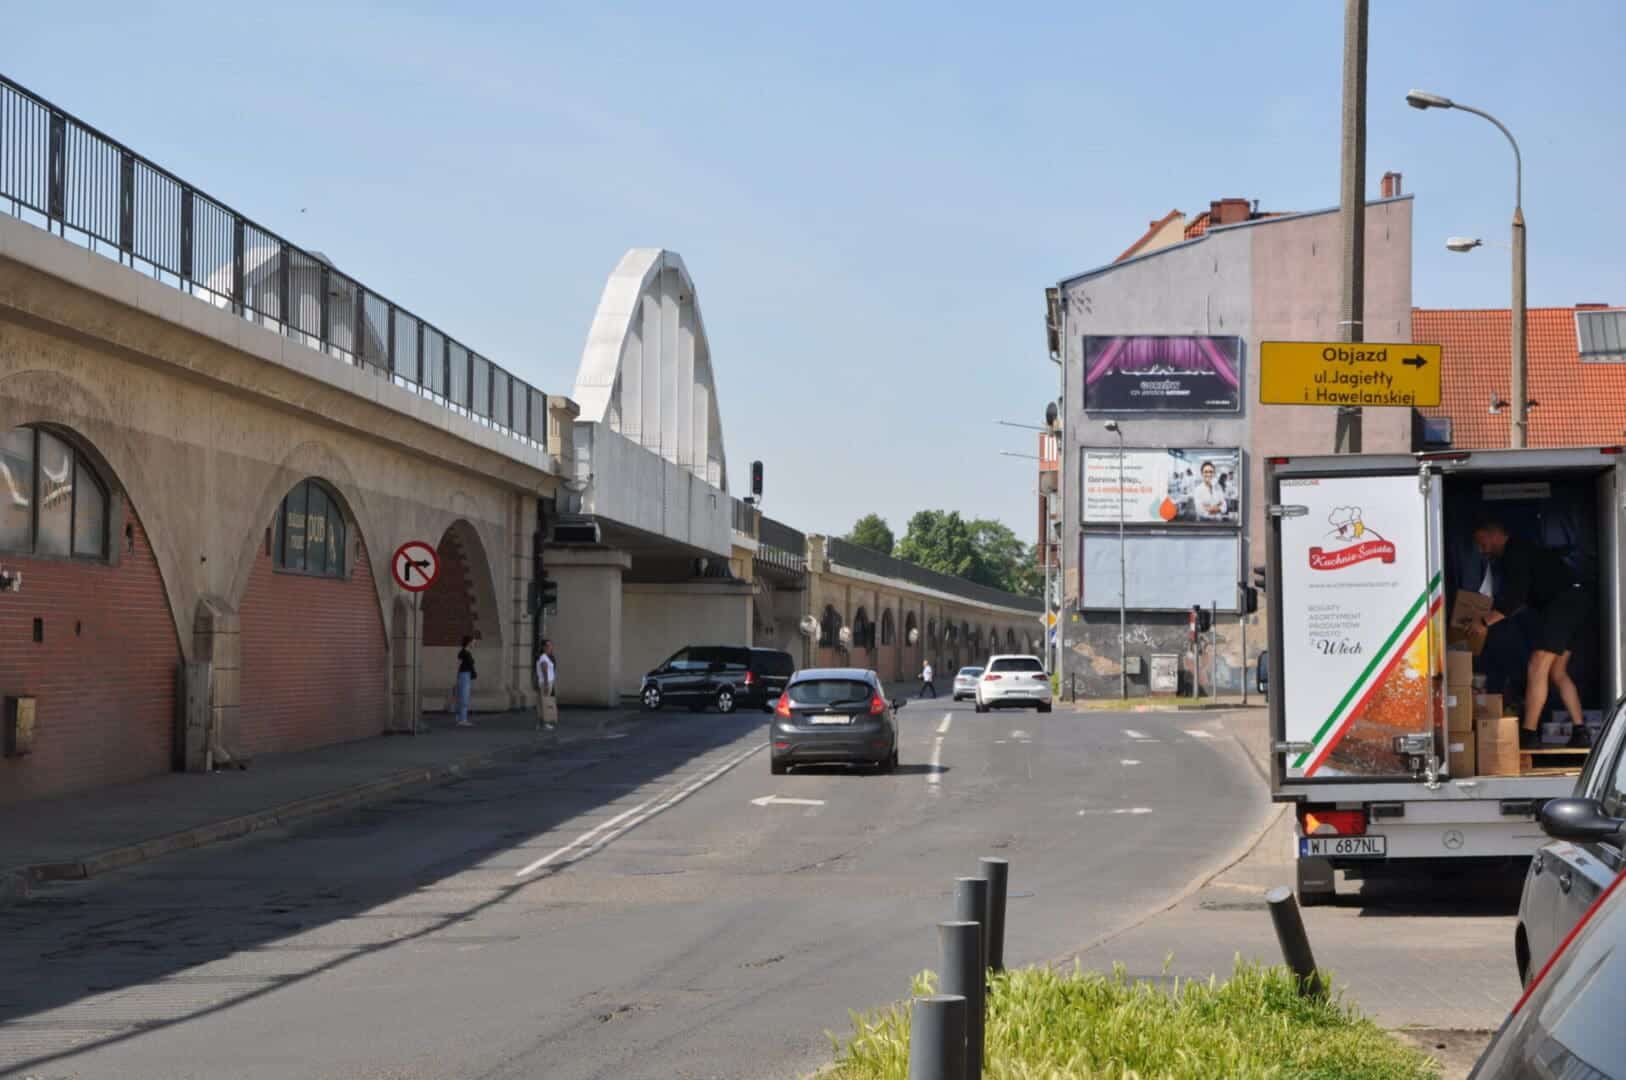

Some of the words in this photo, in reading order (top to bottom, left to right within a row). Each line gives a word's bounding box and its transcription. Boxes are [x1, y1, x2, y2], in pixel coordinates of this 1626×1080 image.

[1322, 347, 1387, 365] Objazd
[1304, 388, 1309, 401] i
[1311, 839, 1327, 854] WI
[1335, 839, 1381, 854] 687NL
